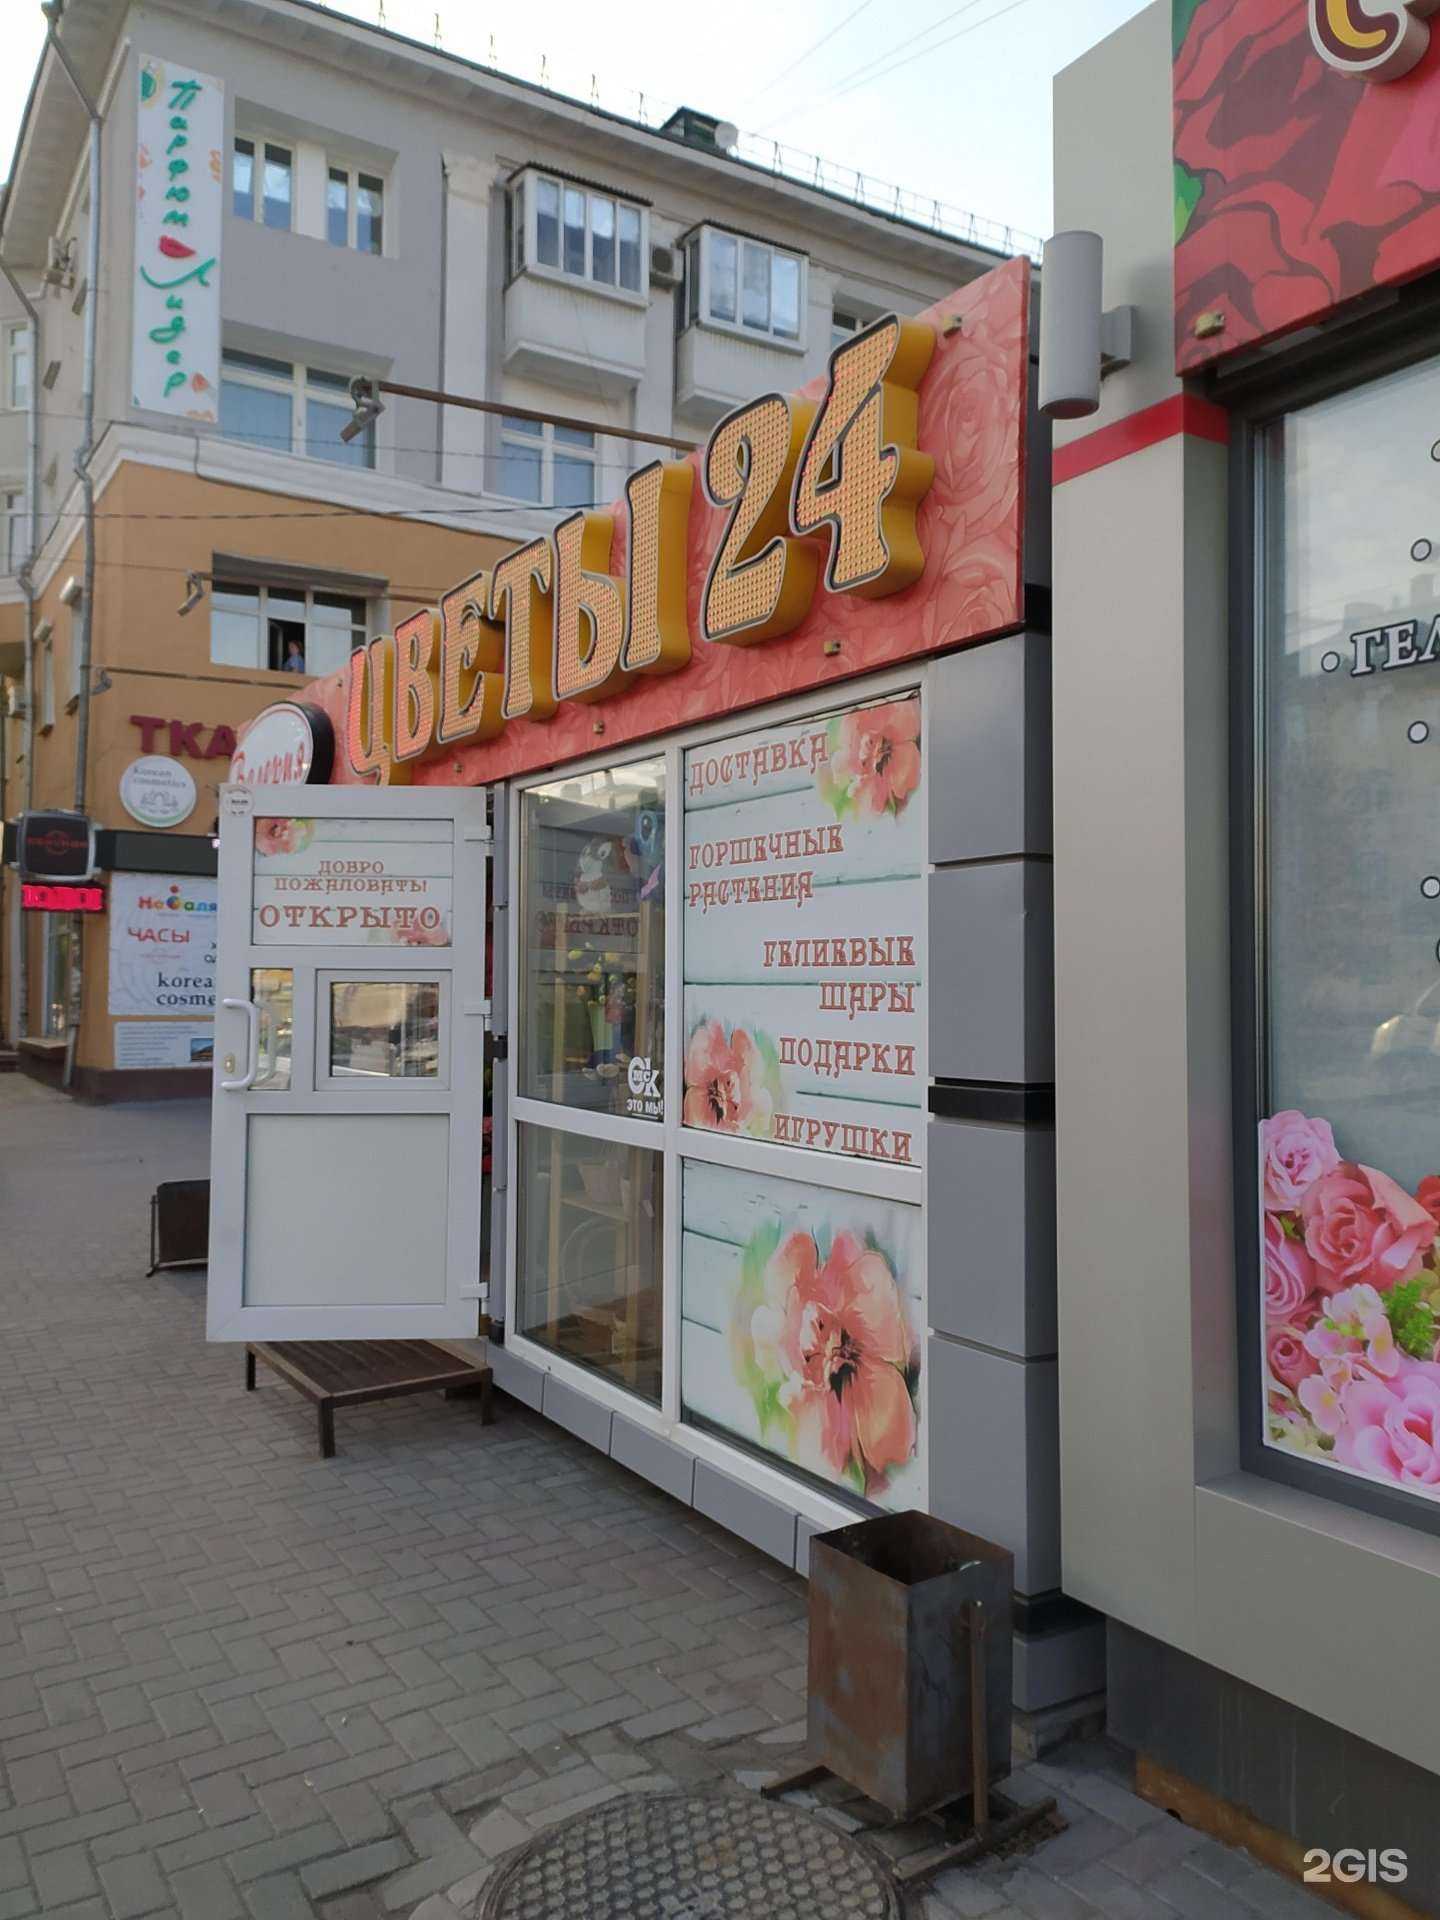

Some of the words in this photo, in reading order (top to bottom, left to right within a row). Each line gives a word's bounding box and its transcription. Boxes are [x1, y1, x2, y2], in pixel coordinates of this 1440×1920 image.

[346, 459, 664, 785] ЦВЕТЫ
[702, 312, 900, 643] 24
[690, 733, 829, 796] ДОСТАВКА
[688, 824, 844, 870] ГОРШЕЧНЫЕ
[319, 860, 384, 875] ДОБРО
[689, 871, 814, 914] РАСТЕНИЯ
[128, 927, 190, 943] ЧАСЫ
[260, 904, 440, 929] ОТКРЫТО
[763, 936, 915, 967] ГЕЛИЕВЫЕ
[158, 972, 213, 988] korea
[819, 982, 915, 1020] ШАРЫ
[779, 1037, 915, 1078] ПОДАРКИ
[774, 1113, 912, 1162] ИГРУШКИ
